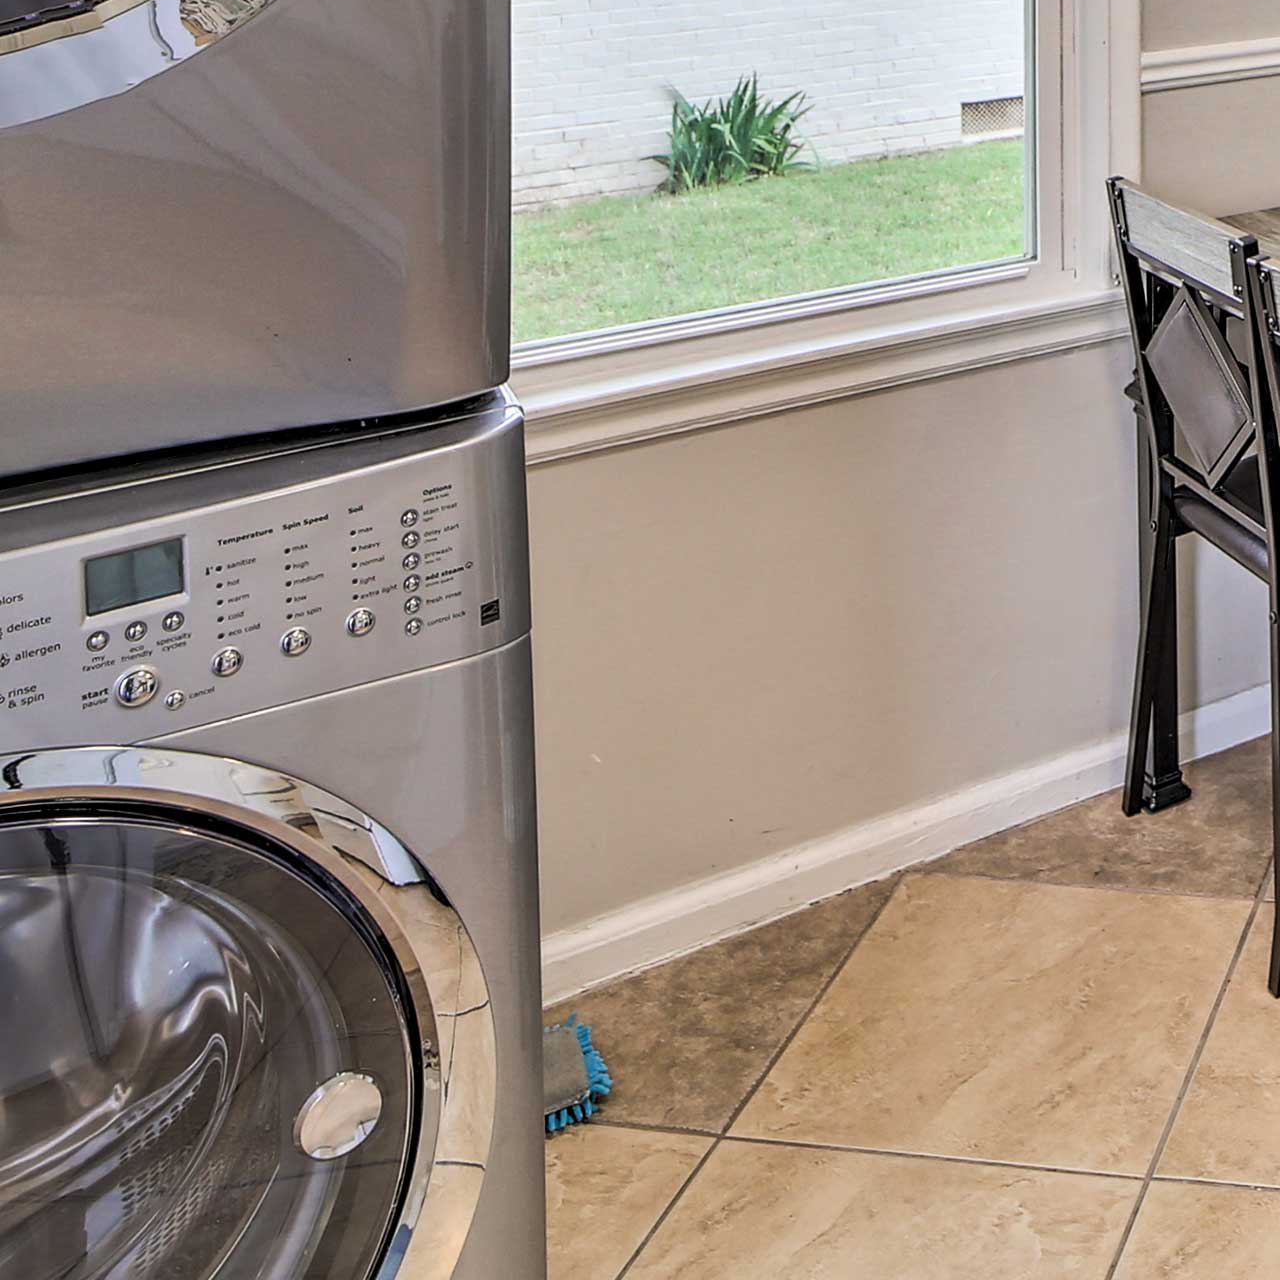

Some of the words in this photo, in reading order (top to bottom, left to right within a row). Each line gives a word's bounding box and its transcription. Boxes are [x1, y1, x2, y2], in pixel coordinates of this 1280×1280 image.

[422, 484, 452, 496] Options
[347, 505, 364, 514] Soil
[282, 521, 302, 531] Spin
[303, 513, 329, 526] Speed
[217, 528, 274, 546] Temperature
[292, 543, 309, 552] max
[358, 542, 381, 551] heavy
[226, 557, 256, 570] sanitize
[292, 560, 309, 570] high
[359, 555, 385, 567] normal
[293, 572, 325, 585] medium
[425, 572, 440, 581] add
[441, 566, 465, 577] steam
[226, 579, 240, 588] hot
[360, 590, 380, 600] extra
[381, 583, 398, 594] light
[0, 593, 24, 606] lors
[227, 593, 250, 604] warm
[293, 595, 308, 603] low
[227, 610, 245, 621] cold
[294, 611, 305, 619] no
[306, 606, 323, 616] spin
[427, 614, 451, 627] control
[451, 610, 467, 619] lock
[6, 616, 52, 634] delicate
[228, 628, 243, 638] eco
[244, 622, 262, 633] cold
[156, 632, 192, 647] specialty
[14, 643, 61, 661] allergen
[129, 645, 145, 653] eco
[161, 641, 187, 653] cycles
[121, 650, 153, 663] friendly
[82, 659, 116, 673] favorite
[8, 684, 37, 698] rinse
[81, 687, 109, 701] start
[188, 686, 216, 700] cancel
[8, 700, 17, 709] &
[20, 692, 45, 706] spin
[81, 697, 109, 710] pause
